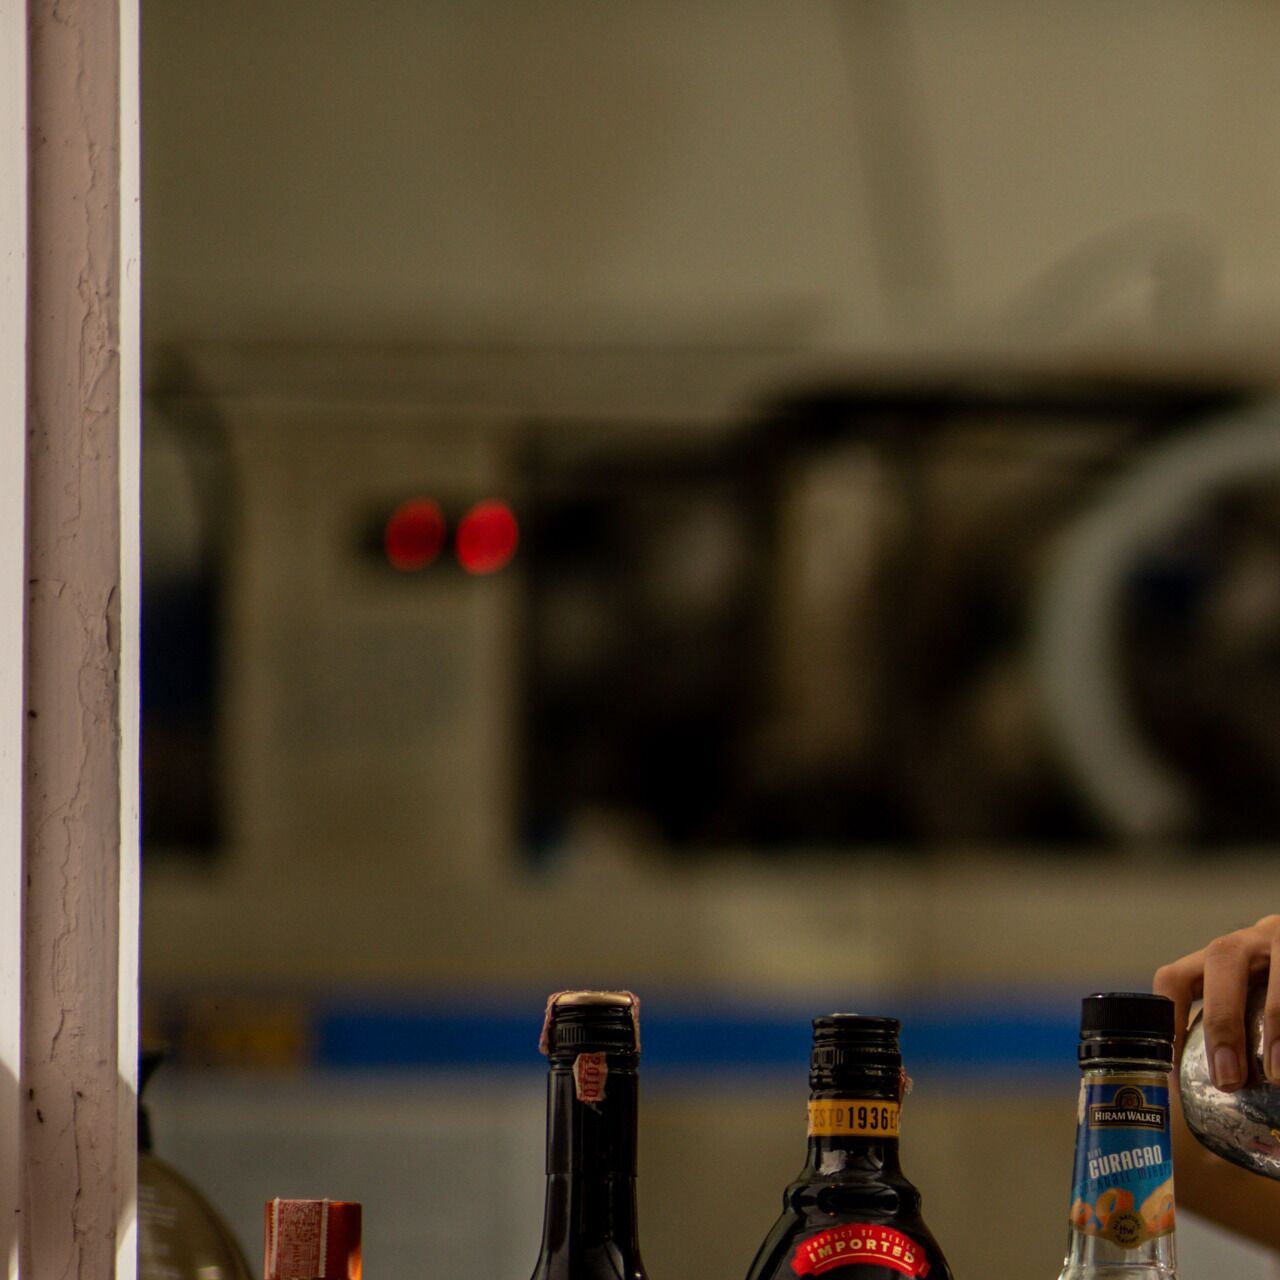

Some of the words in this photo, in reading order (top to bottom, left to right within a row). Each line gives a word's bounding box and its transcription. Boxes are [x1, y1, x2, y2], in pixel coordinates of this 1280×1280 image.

[848, 1106, 888, 1130] 1936
[1095, 1111, 1126, 1121] HIRAM
[1126, 1111, 1161, 1124] WALKER
[1088, 1144, 1163, 1179] CURACAO
[808, 1238, 916, 1264] IMPORTED
